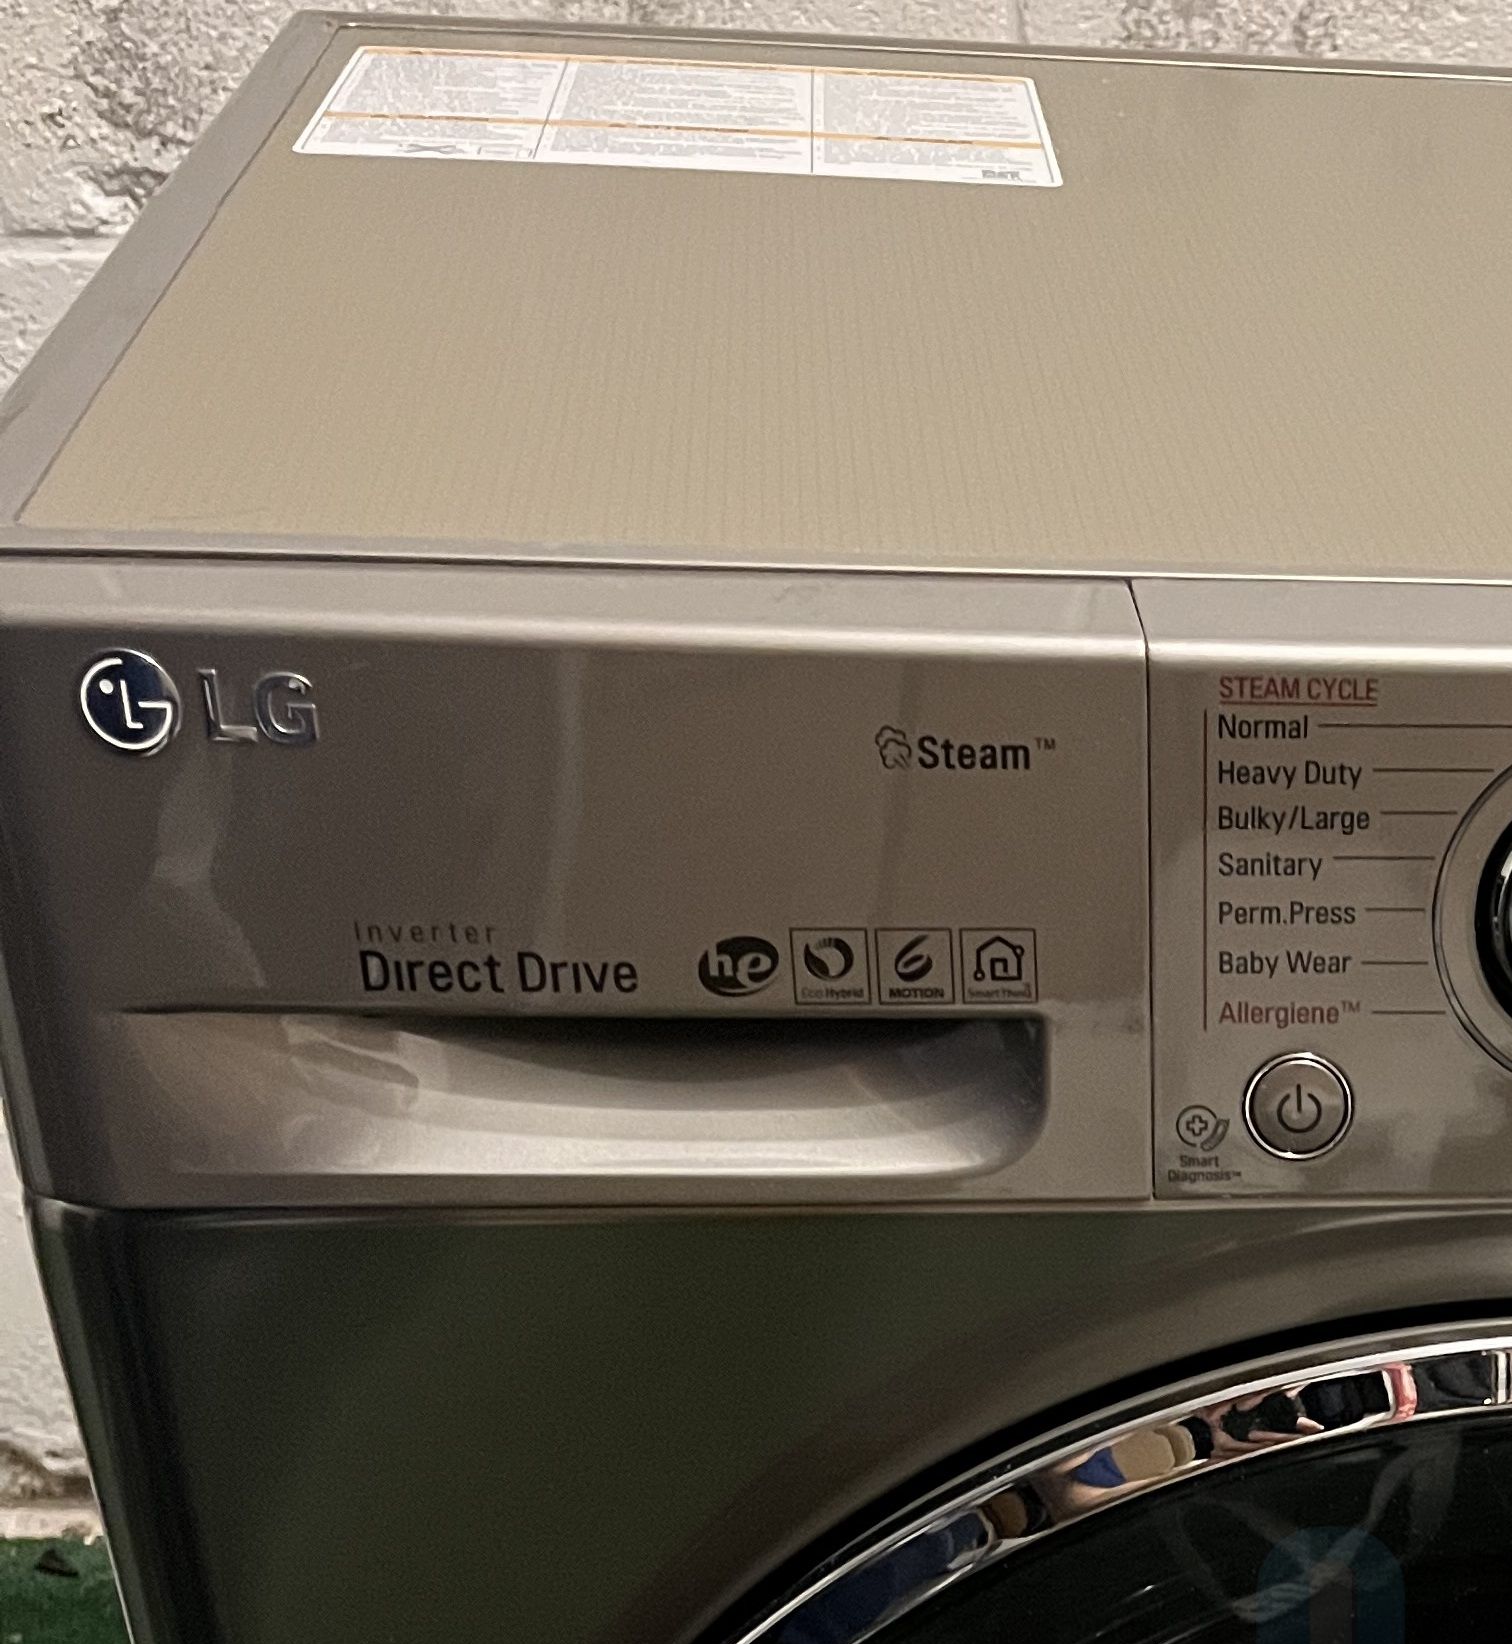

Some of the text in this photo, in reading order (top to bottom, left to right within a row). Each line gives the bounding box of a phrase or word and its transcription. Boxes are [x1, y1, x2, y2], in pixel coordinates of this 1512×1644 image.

[1219, 676, 1379, 701] STEAM CYCLE
[197, 668, 320, 743] LG
[1218, 715, 1309, 739] Normal
[1218, 760, 1362, 790] Heavy Duty
[1218, 806, 1371, 836] Bulky/Large
[1218, 853, 1323, 881] Sanitary
[1218, 902, 1357, 926] Perm.Press
[354, 921, 496, 945] Inverter
[359, 950, 639, 994] Direct Drive
[1218, 951, 1351, 979] Baby Wear
[888, 986, 945, 999] MOTION
[1180, 1154, 1219, 1168] Smart
